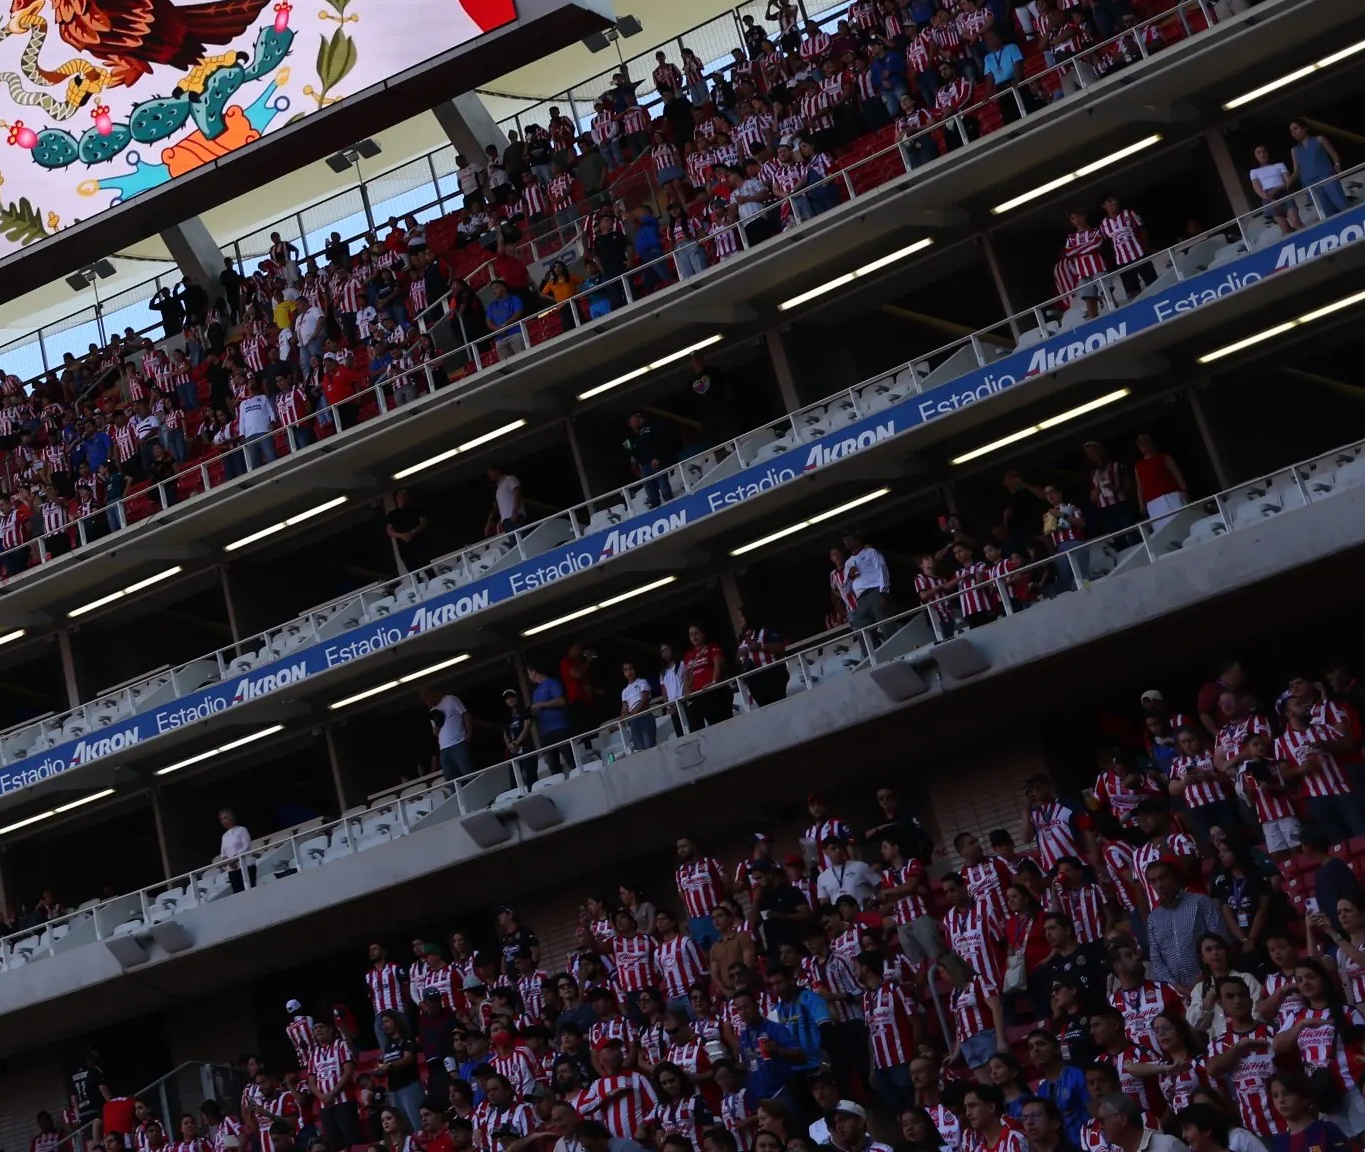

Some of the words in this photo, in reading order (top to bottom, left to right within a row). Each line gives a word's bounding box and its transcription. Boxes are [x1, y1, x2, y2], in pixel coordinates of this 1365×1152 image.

[1025, 322, 1126, 379] AKRON
[708, 469, 795, 511] Estadio
[804, 421, 894, 472] AKRON
[510, 552, 592, 593] Estadio
[600, 510, 686, 558] AKRON
[326, 628, 401, 667] Estadio
[407, 590, 488, 636] AKRON
[157, 696, 226, 733] Estadio
[232, 661, 305, 705] AKRON
[0, 759, 64, 793] Estadio
[69, 727, 138, 768] AKRON
